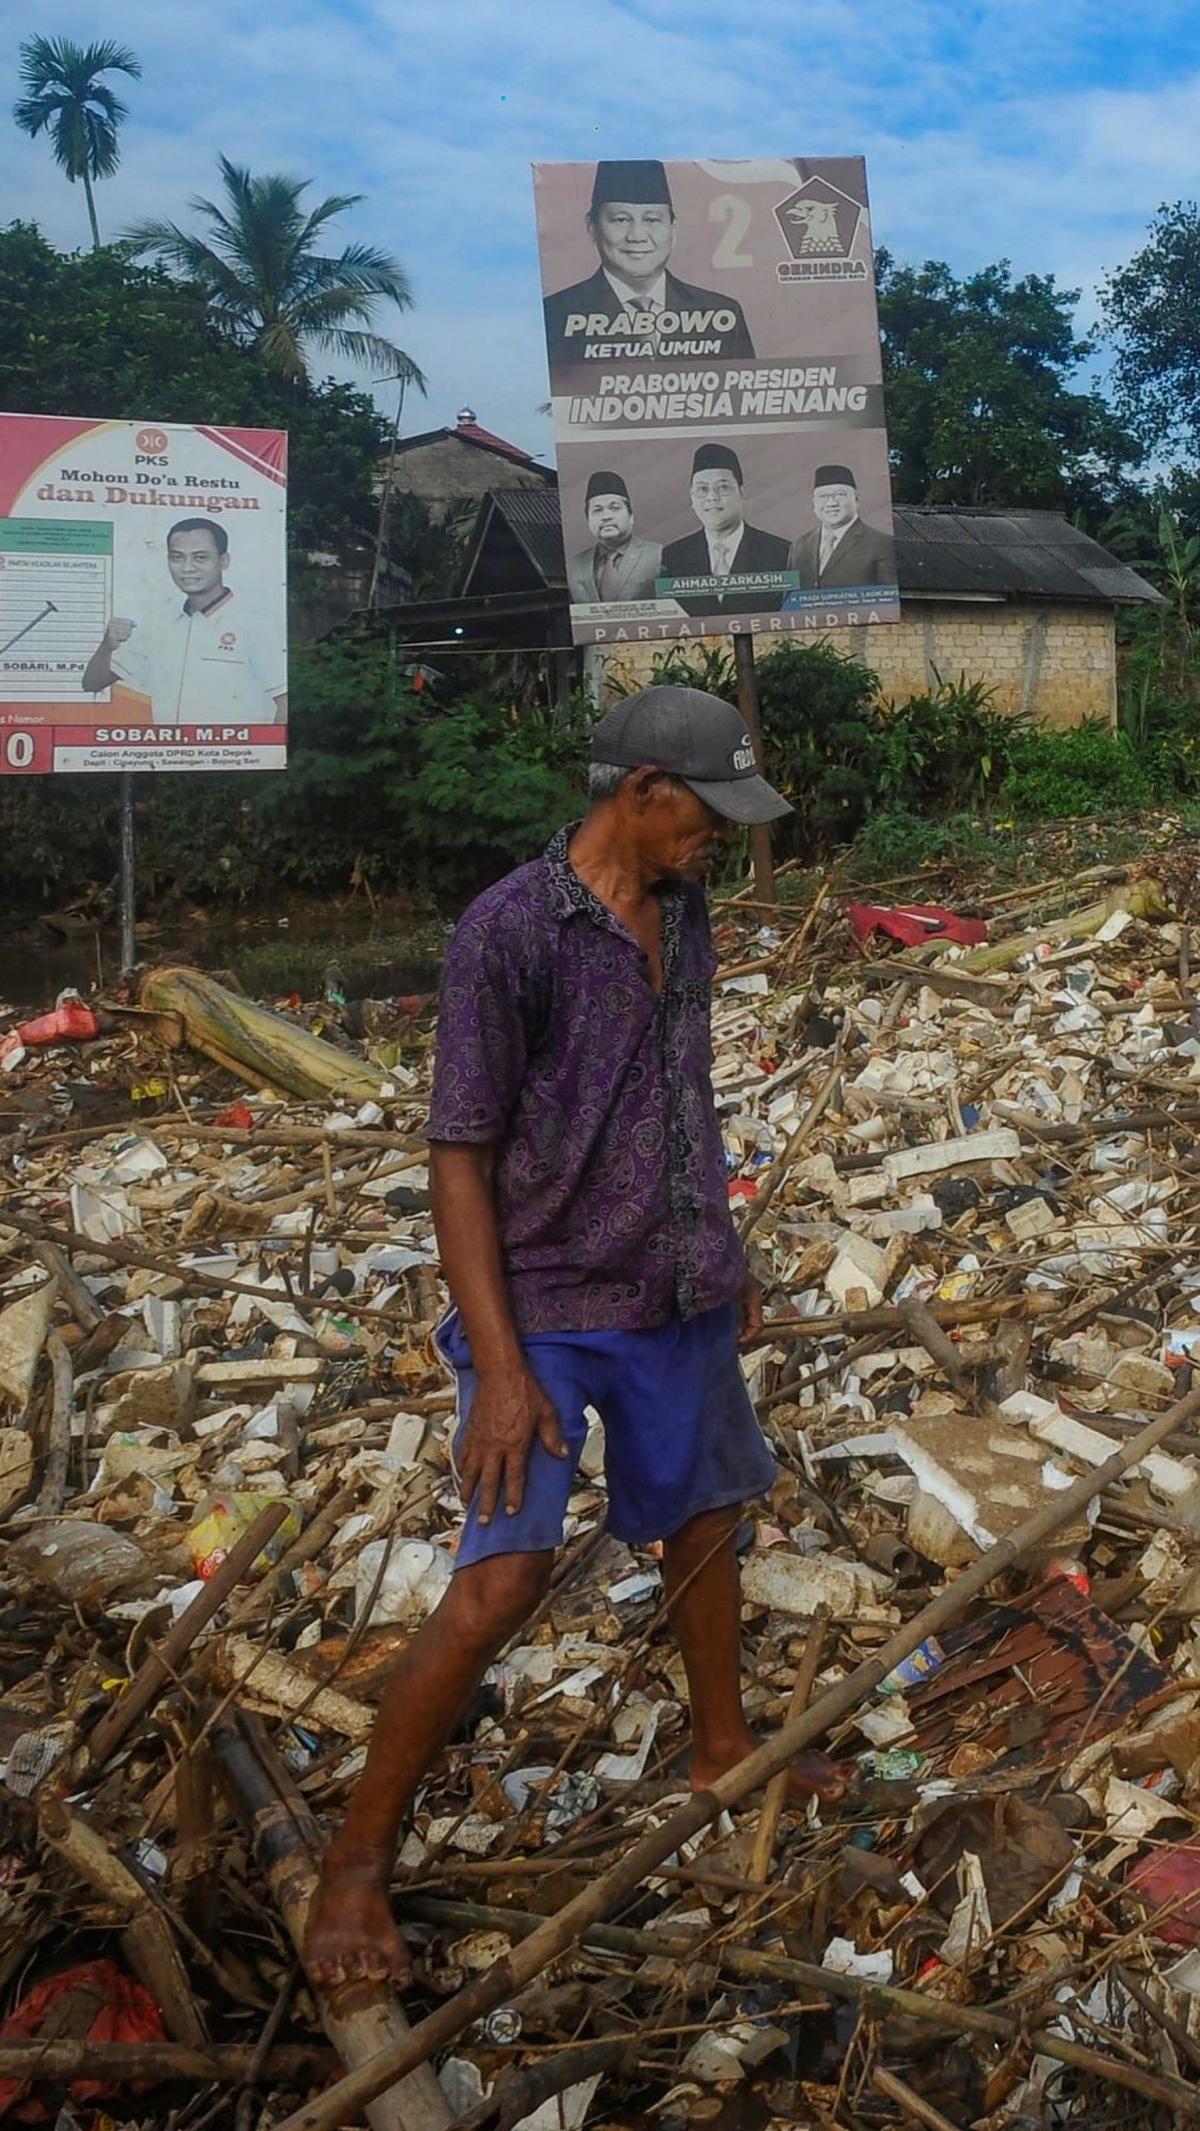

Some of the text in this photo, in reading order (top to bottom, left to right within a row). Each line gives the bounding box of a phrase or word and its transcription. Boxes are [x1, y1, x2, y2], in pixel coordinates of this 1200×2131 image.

[708, 194, 753, 268] 2
[778, 261, 866, 275] GERINDRA
[564, 309, 737, 337] PRABOWO
[584, 339, 721, 359] KETUA UMUM
[600, 367, 836, 395] PRABOWO PRESIDEN
[569, 386, 867, 424] INDONESIA MENANG
[135, 455, 168, 466] PKS
[60, 469, 240, 489] Mohon Do'a Restu
[37, 484, 260, 513] dan Dukungan
[672, 574, 783, 589] AHMAD ZARKASIH
[595, 611, 881, 641] PARTAI GERINDRA
[3, 662, 52, 671] SOBARI,
[95, 728, 249, 743] SOBARI, M.Pd
[122, 750, 163, 759] Anggota
[166, 749, 195, 757] DPRD
[222, 749, 252, 757] Depok
